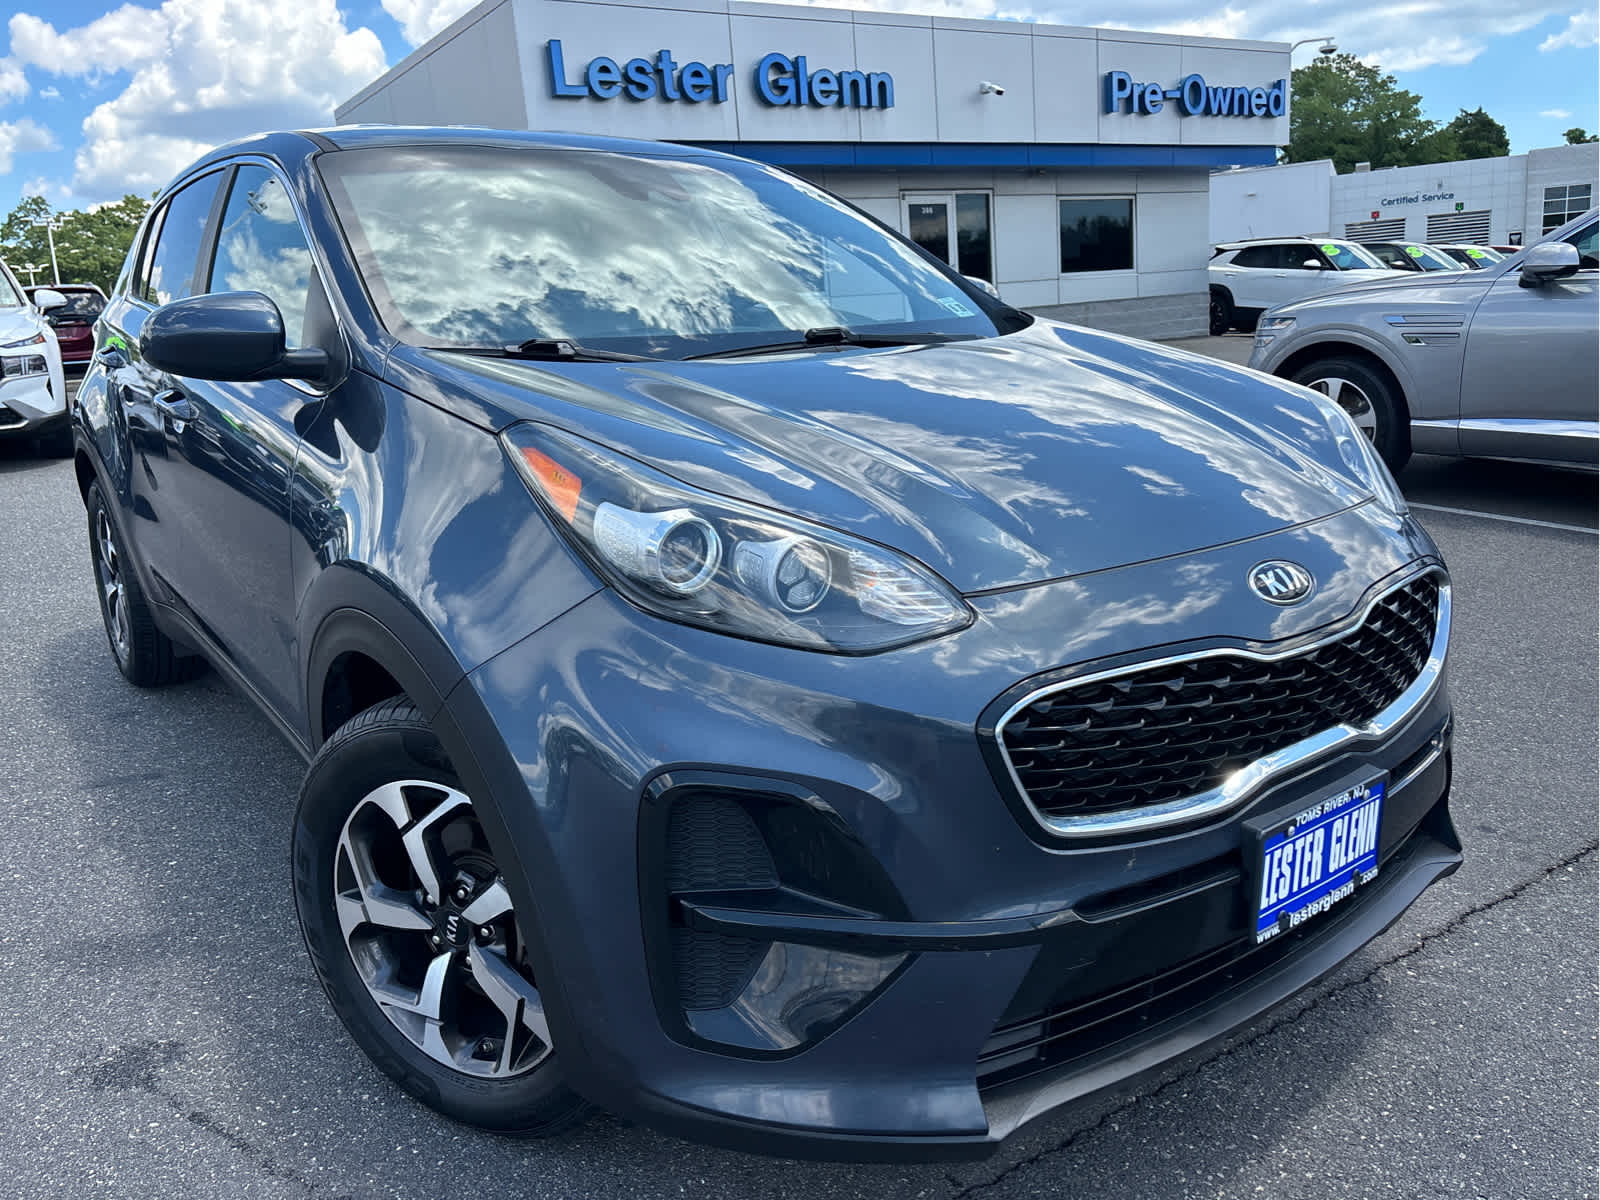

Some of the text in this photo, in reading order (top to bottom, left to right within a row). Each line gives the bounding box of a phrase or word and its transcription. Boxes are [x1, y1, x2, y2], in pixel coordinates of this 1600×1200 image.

[546, 39, 895, 109] Lester Glenn
[1104, 70, 1286, 117] Pre-Owned
[1381, 192, 1455, 206] Certified Service
[1257, 565, 1309, 597] KIA
[1296, 806, 1322, 828] TOMS
[1353, 784, 1365, 800] NJ
[1259, 799, 1380, 910] LESTER GLENN
[1289, 882, 1355, 928] lesterglenn
[446, 915, 459, 943] KIA
